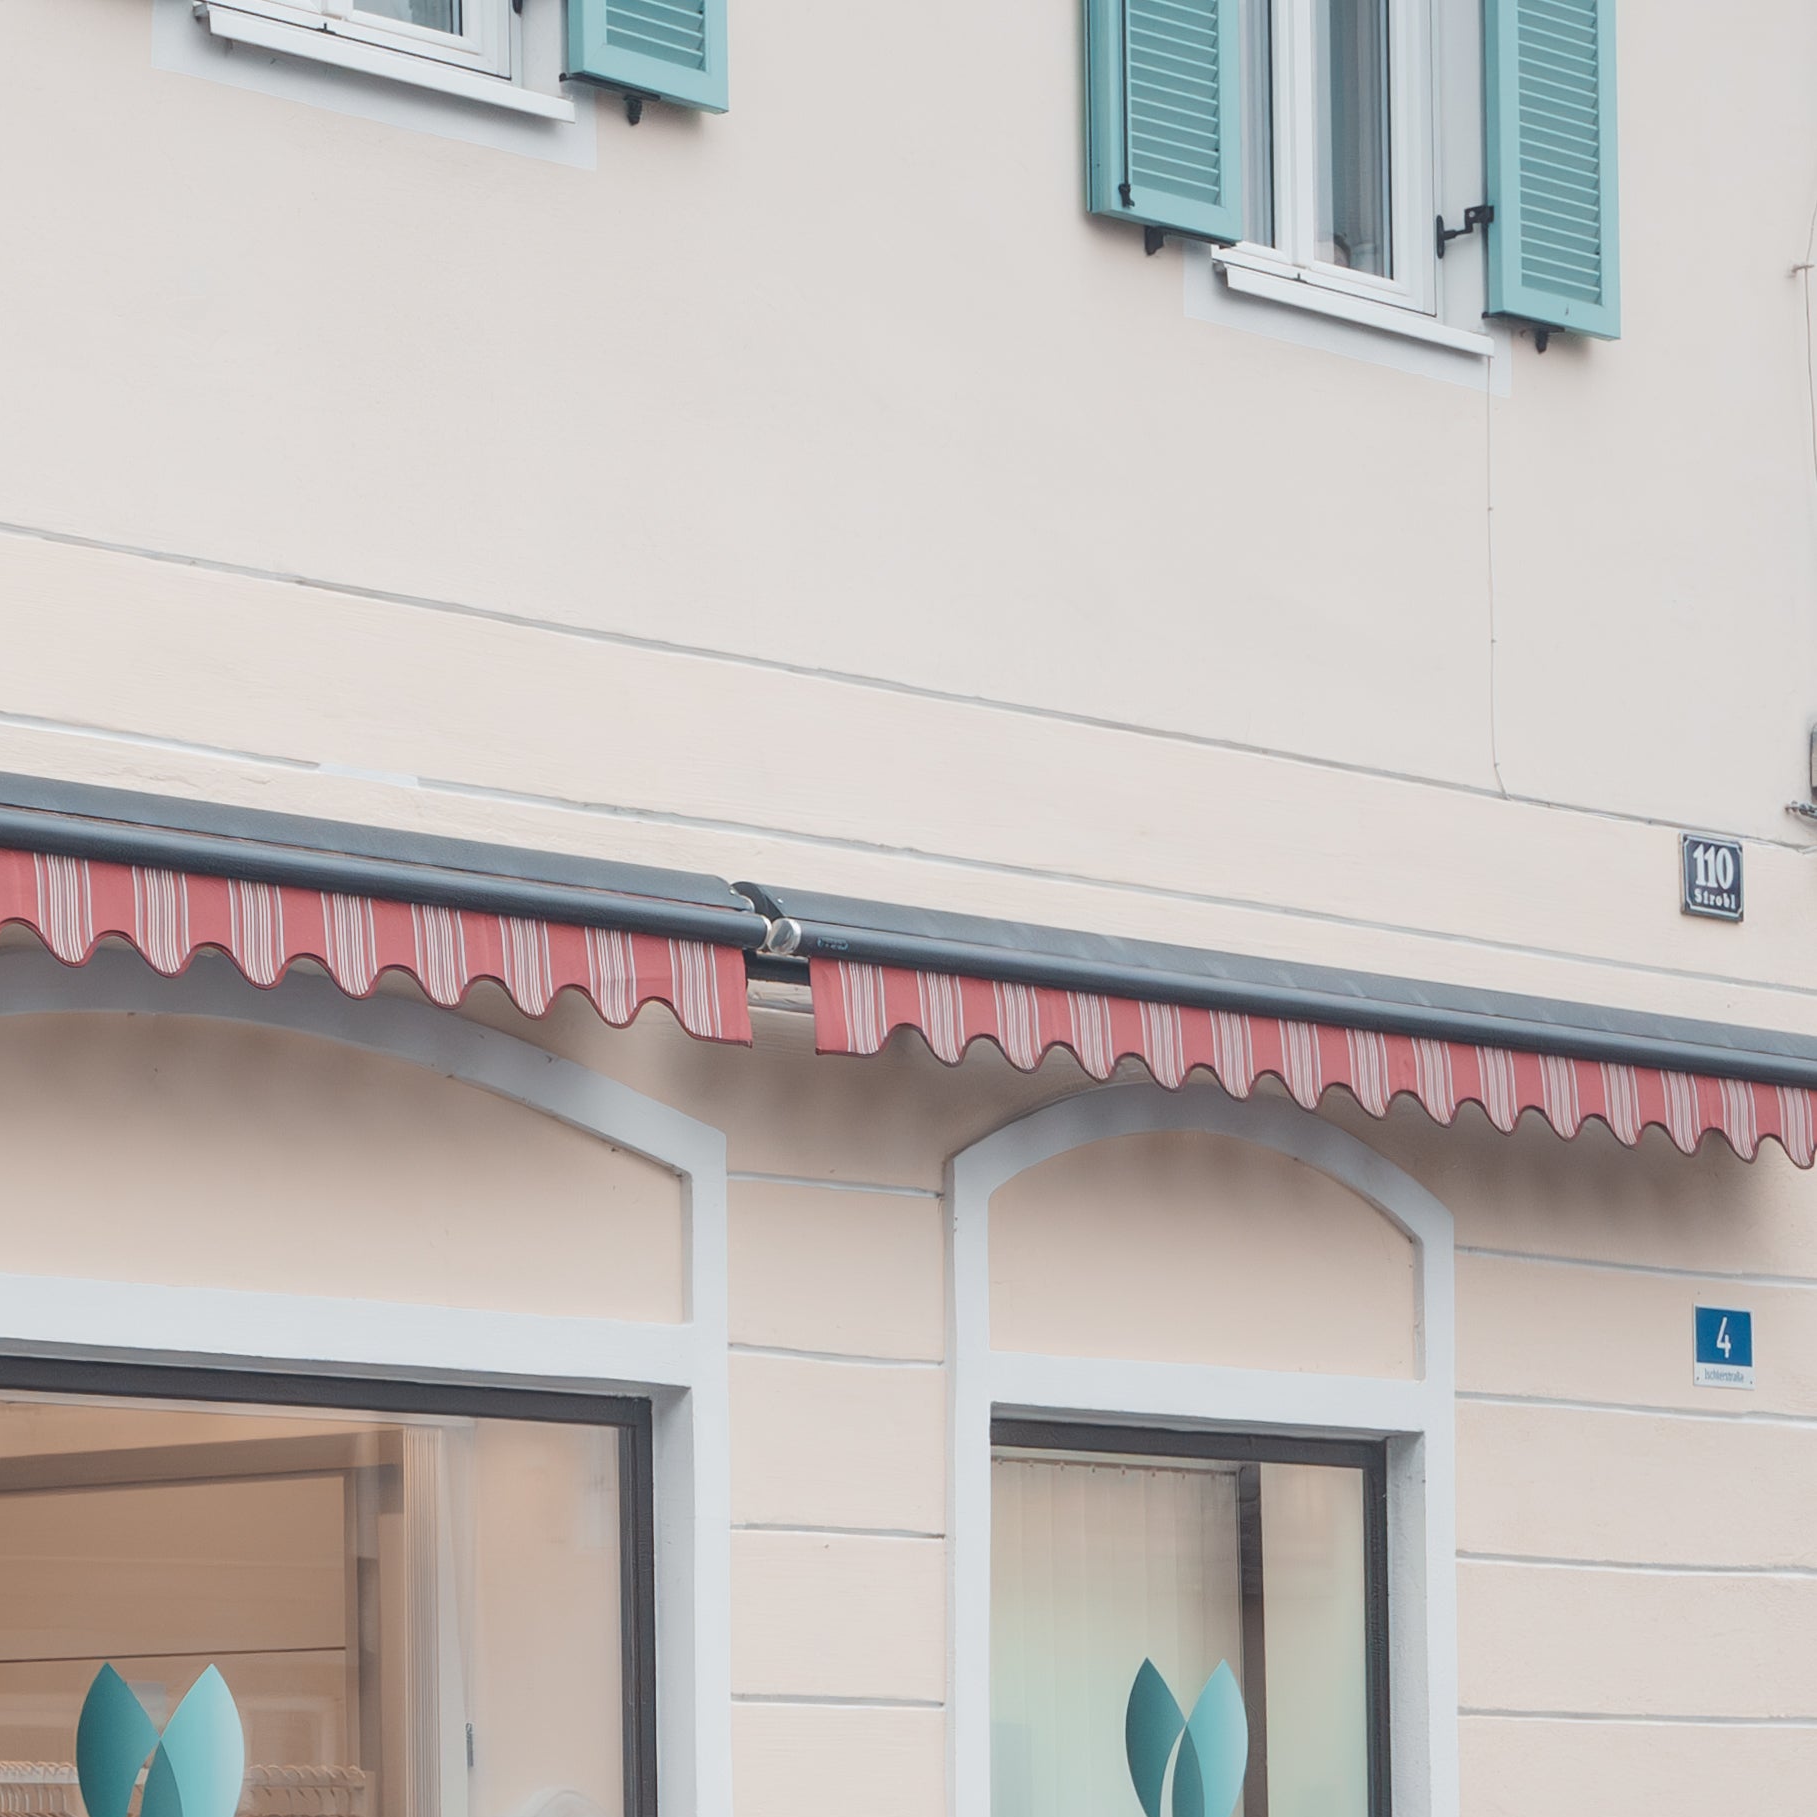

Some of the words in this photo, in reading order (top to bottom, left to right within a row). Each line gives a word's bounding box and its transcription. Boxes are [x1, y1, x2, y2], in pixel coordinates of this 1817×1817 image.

[1693, 843, 1734, 889] 110
[1694, 888, 1736, 910] Strobl
[1716, 1317, 1732, 1359] 4
